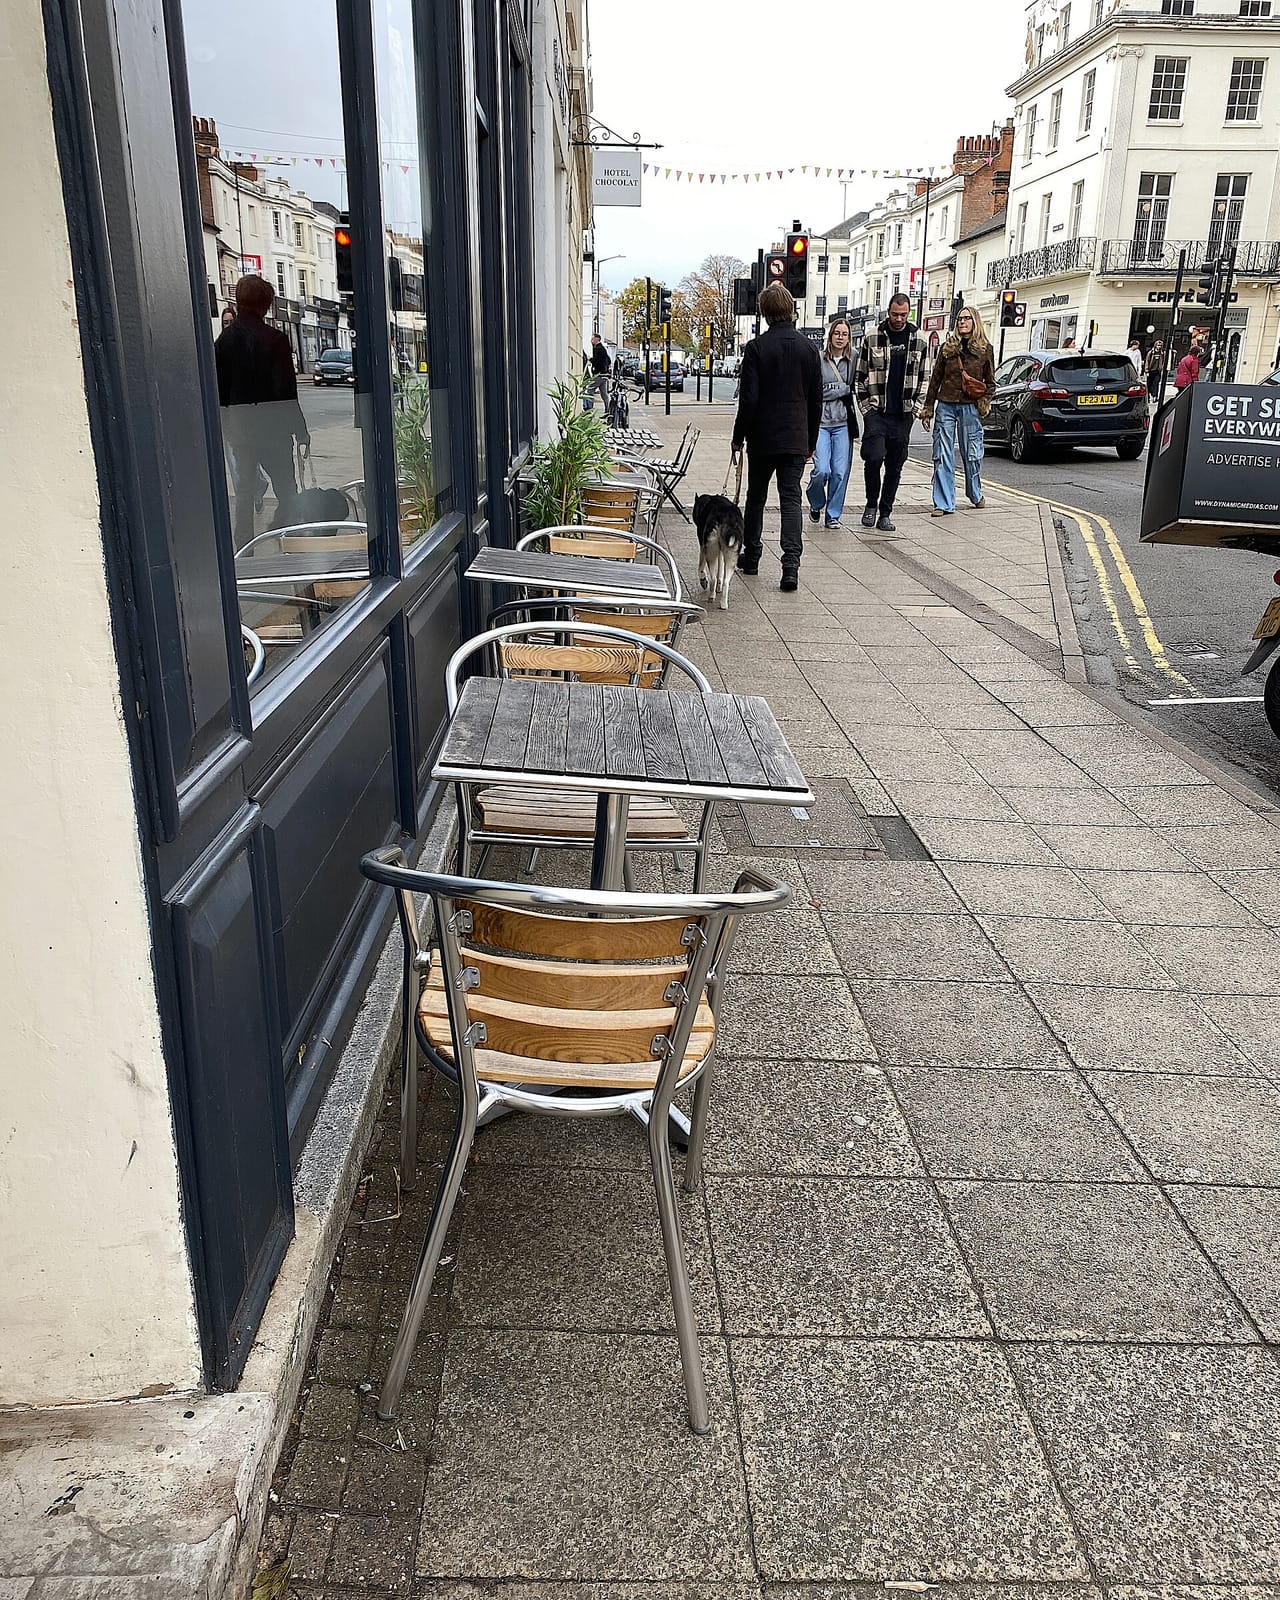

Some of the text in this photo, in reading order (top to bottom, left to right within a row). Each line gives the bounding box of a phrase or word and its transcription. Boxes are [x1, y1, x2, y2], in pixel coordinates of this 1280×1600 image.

[603, 169, 631, 177] HOTEL
[595, 178, 639, 187] CHOCOLAT
[1080, 396, 1098, 404] LF23
[1207, 395, 1253, 417] GET
[1206, 453, 1272, 468] ADVERTISE
[1194, 500, 1279, 511] WWW.DYNAMICMEDIAS.COM
